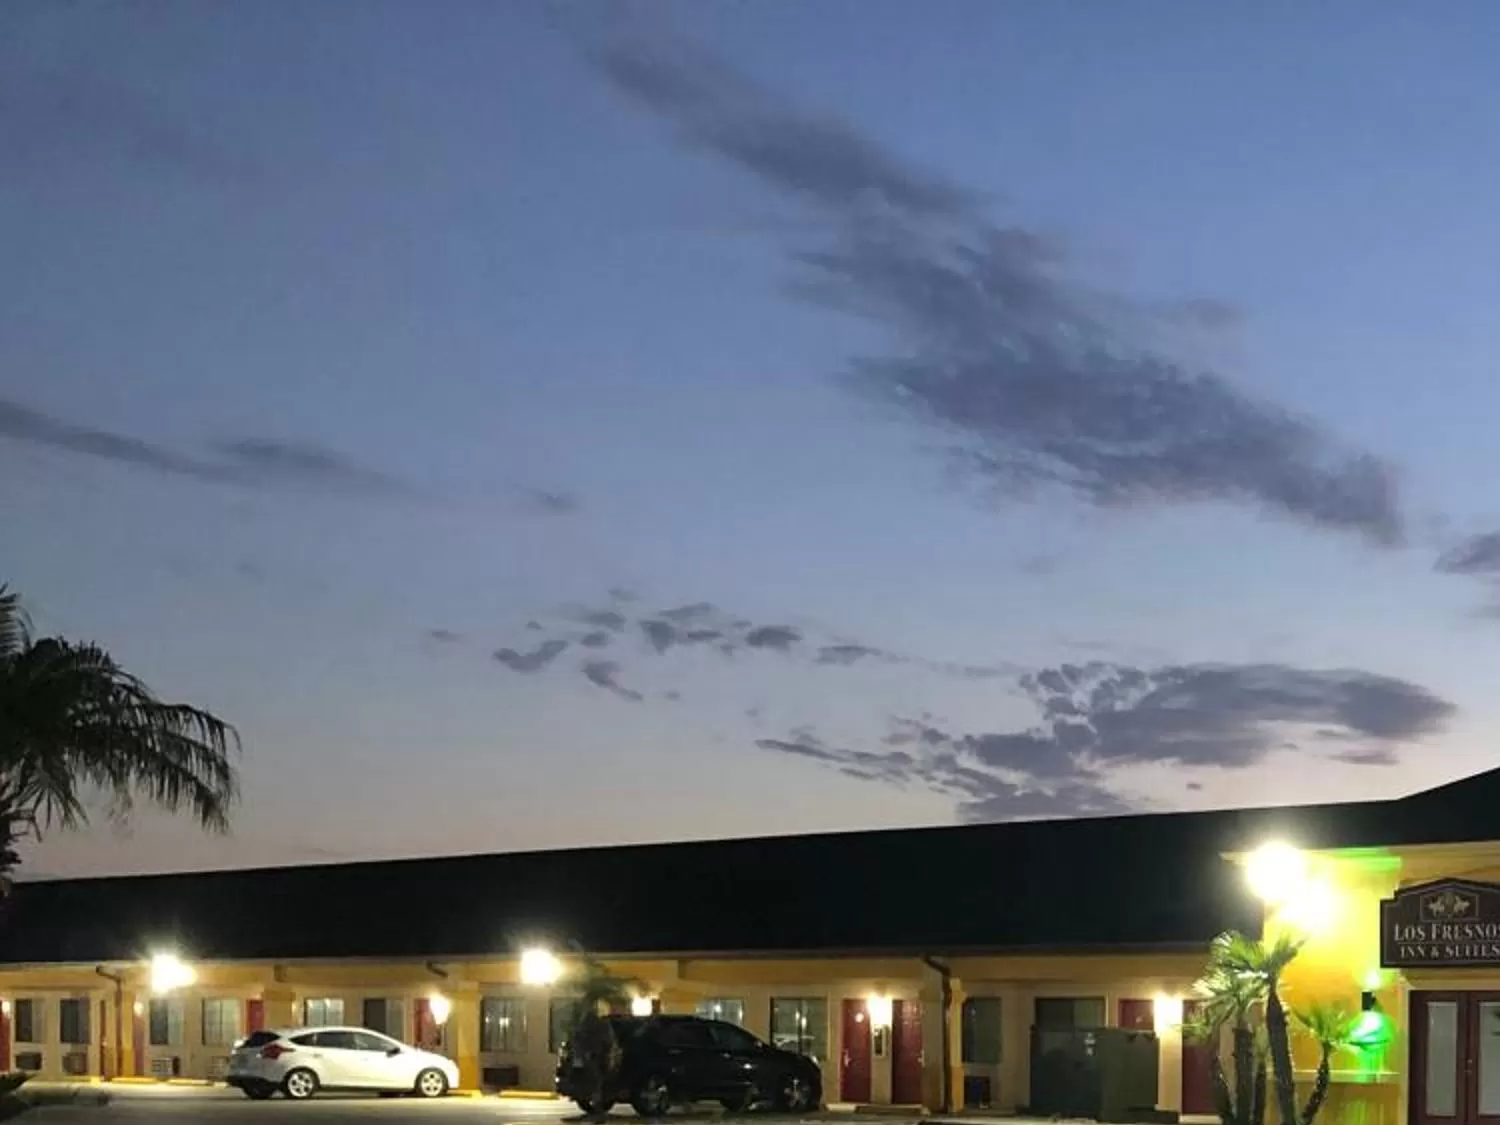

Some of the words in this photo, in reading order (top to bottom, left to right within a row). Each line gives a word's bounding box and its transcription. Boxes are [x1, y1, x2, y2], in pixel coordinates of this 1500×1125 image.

[1394, 922, 1425, 941] LOS
[1400, 944, 1425, 958] INN
[1431, 945, 1440, 958] &
